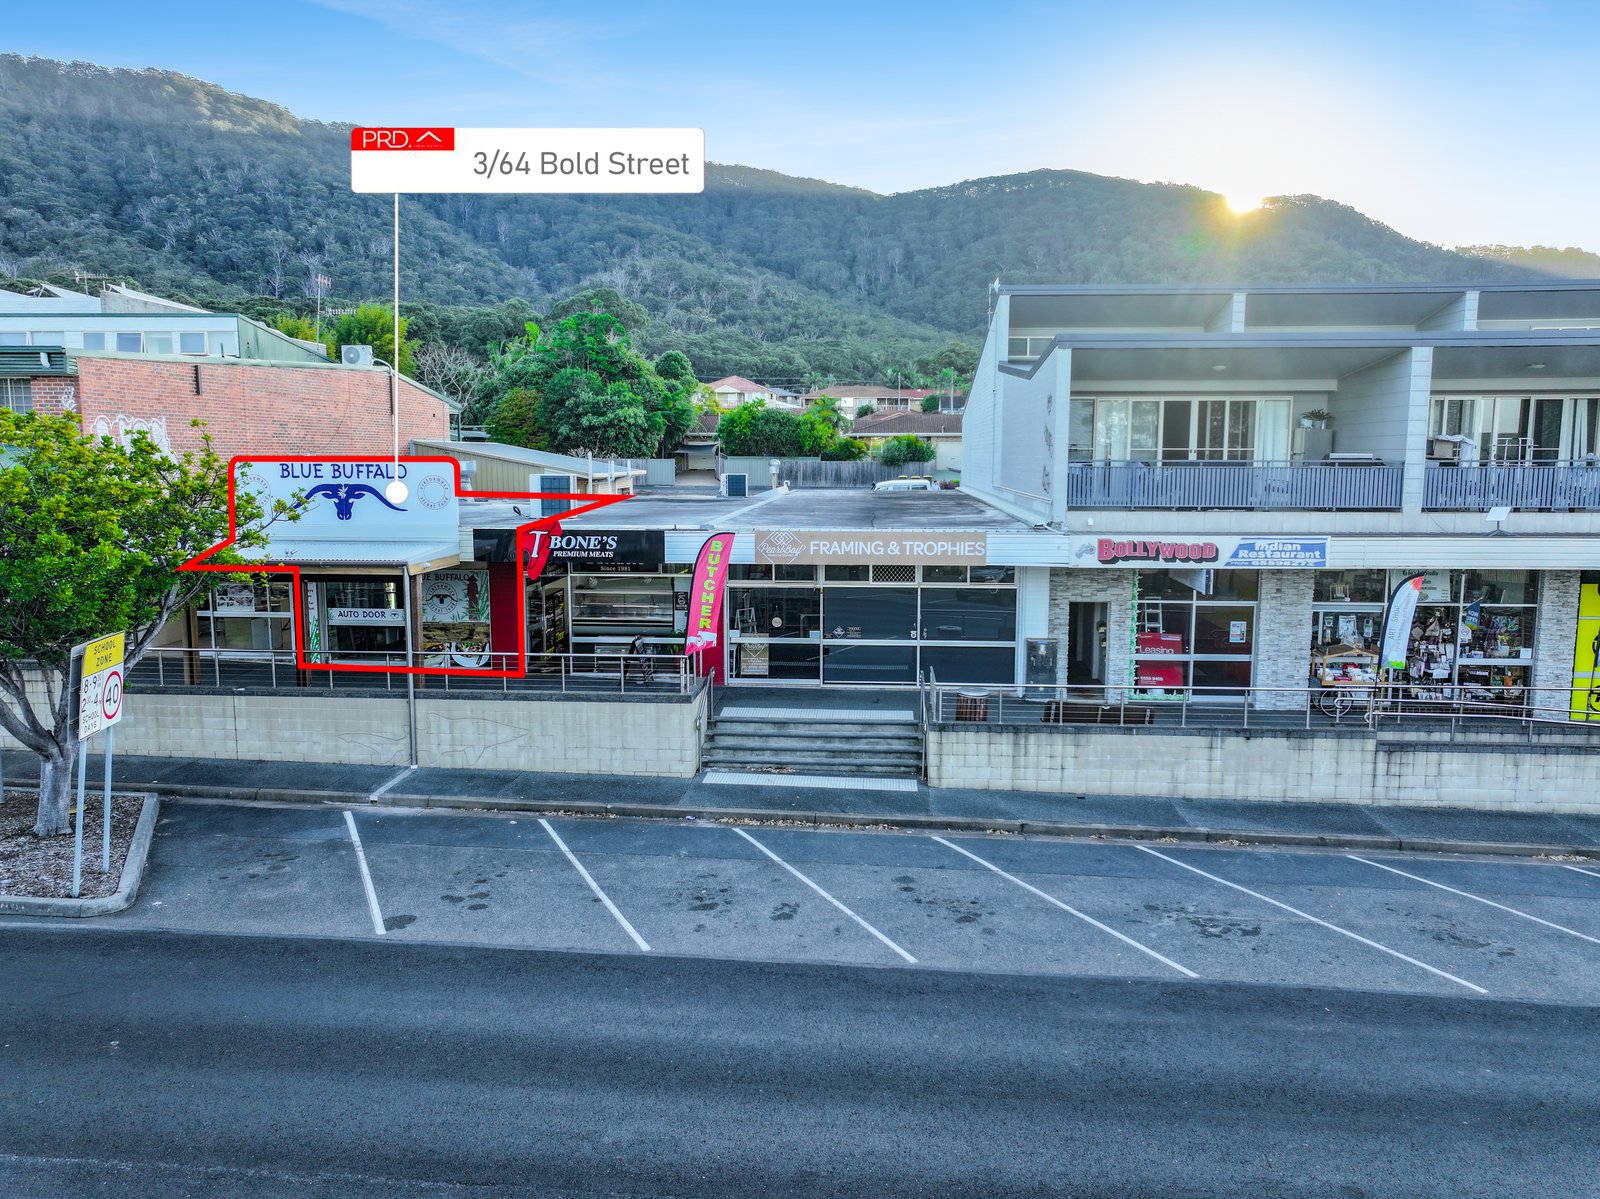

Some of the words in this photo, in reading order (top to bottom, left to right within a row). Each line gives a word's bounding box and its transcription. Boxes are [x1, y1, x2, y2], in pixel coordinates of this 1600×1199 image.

[279, 463, 324, 479] BLUE
[330, 463, 408, 479] BUFFALO
[528, 530, 549, 558] T
[548, 535, 618, 550] BONE'S
[810, 541, 884, 555] FRAMING
[887, 541, 900, 555] &
[902, 541, 986, 556] TROPHIES
[1097, 538, 1219, 563] BOLLYWOOD
[1254, 542, 1301, 551] Indian
[1237, 550, 1321, 559] Restaurant
[435, 573, 470, 581] BUFFALO
[699, 540, 723, 629] BUTCHER
[338, 610, 360, 618] AUTO
[362, 611, 387, 619] DOOR
[94, 640, 116, 655] SCHOOL
[96, 653, 113, 667] ZONE
[105, 683, 120, 705] 40
